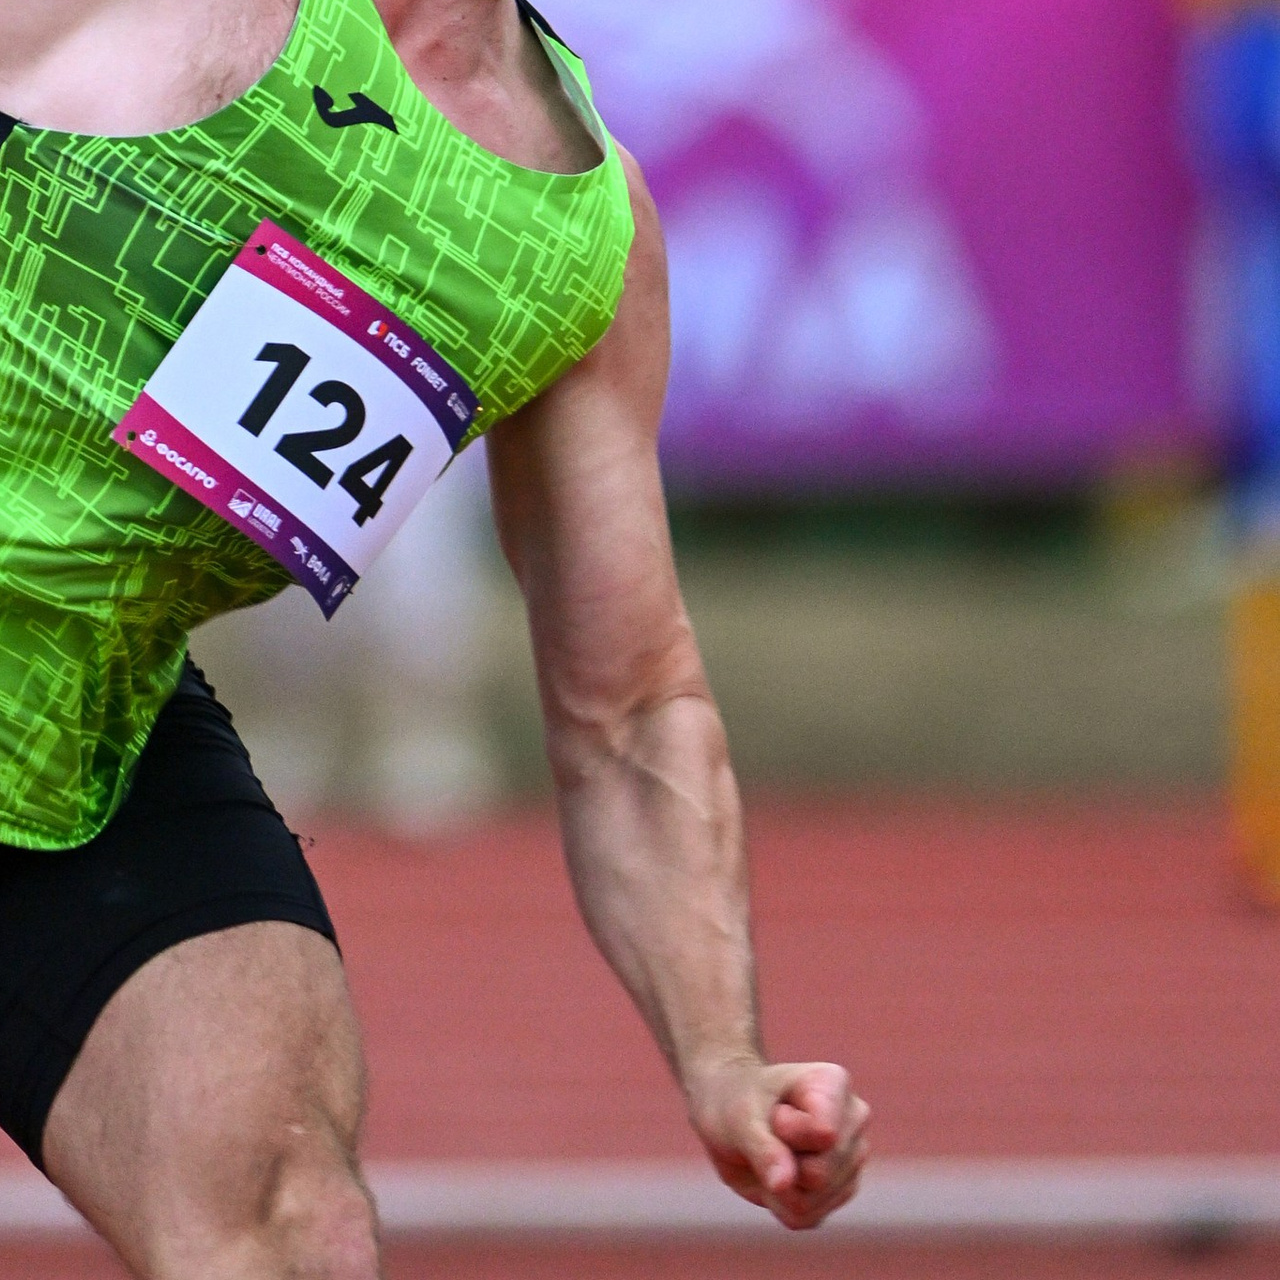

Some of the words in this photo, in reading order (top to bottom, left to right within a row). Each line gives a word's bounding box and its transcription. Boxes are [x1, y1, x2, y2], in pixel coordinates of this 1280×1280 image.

[383, 331, 411, 359] ПСБ
[410, 356, 449, 392] FONBET
[237, 342, 414, 528] 124
[155, 442, 217, 489] ФОСАГРО
